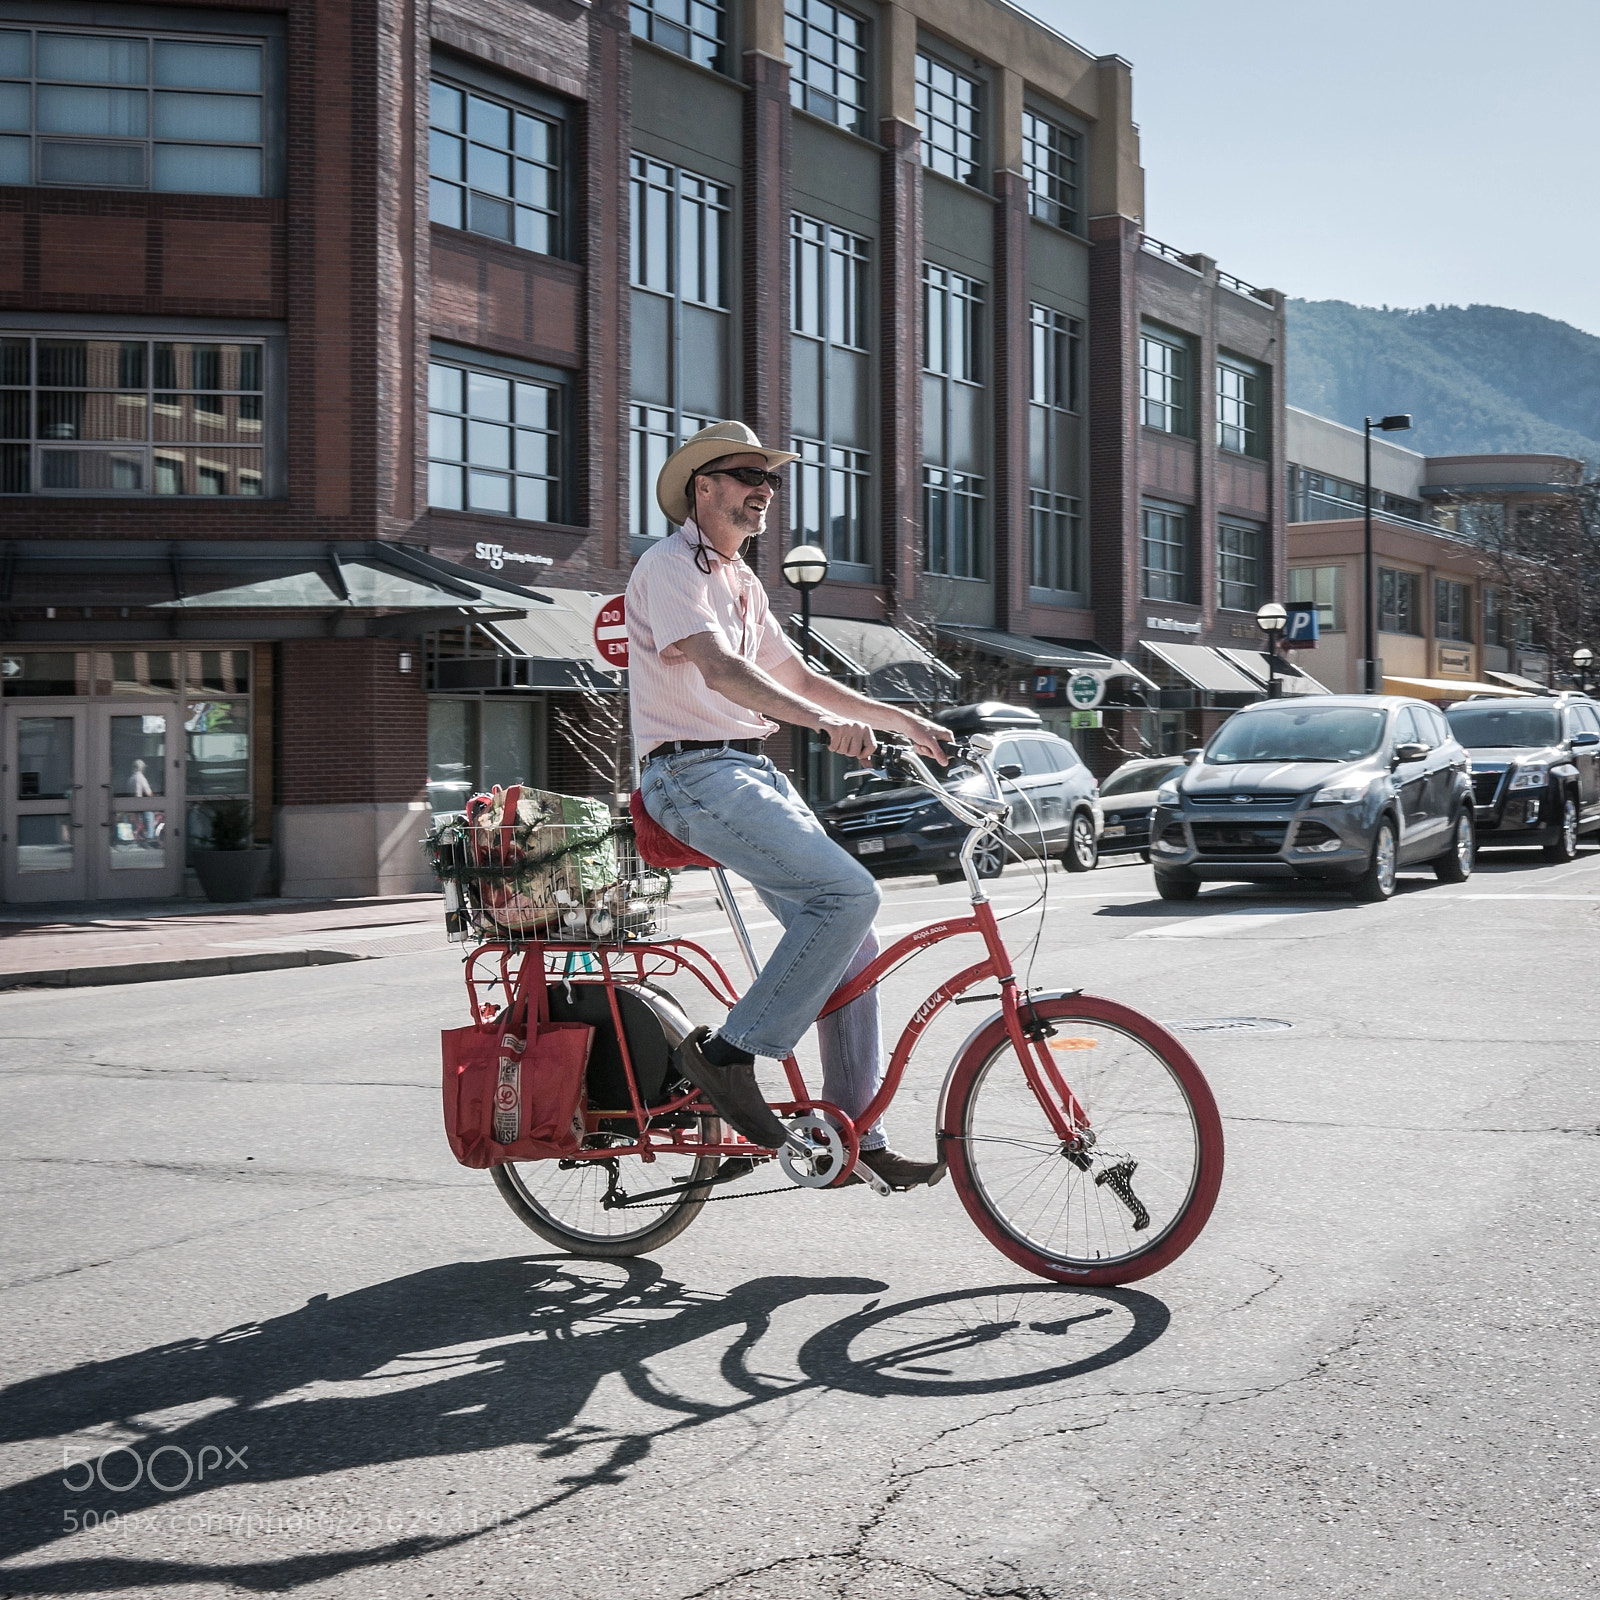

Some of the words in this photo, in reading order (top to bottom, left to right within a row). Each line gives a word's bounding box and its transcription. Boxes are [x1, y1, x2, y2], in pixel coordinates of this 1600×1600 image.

[475, 542, 503, 569] srg
[602, 610, 621, 623] DO
[1289, 612, 1310, 639] P
[608, 642, 628, 655] ENT
[1035, 676, 1048, 691] P
